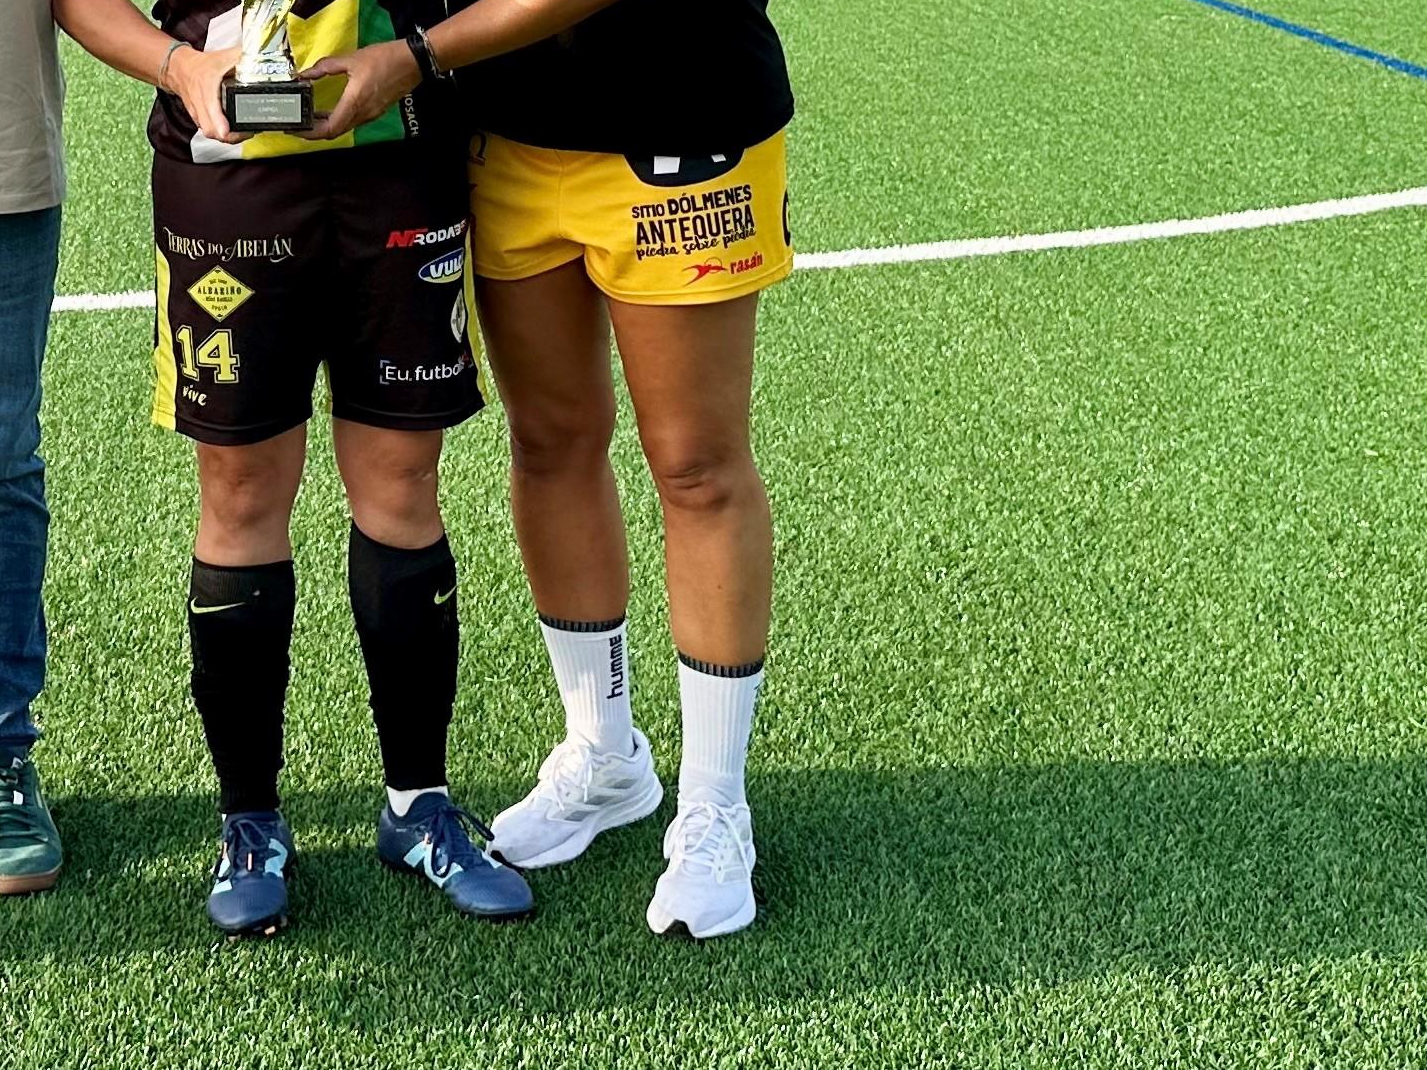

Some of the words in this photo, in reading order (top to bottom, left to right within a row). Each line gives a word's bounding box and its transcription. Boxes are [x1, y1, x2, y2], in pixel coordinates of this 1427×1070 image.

[632, 203, 665, 218] SITIO
[667, 184, 752, 215] DÓLMENES
[636, 204, 755, 245] ANTEQUERA
[163, 226, 205, 260] TERRAS
[207, 242, 223, 255] DO
[221, 234, 295, 263] ABELÁN
[730, 251, 763, 274] rasán
[176, 324, 240, 384] 14
